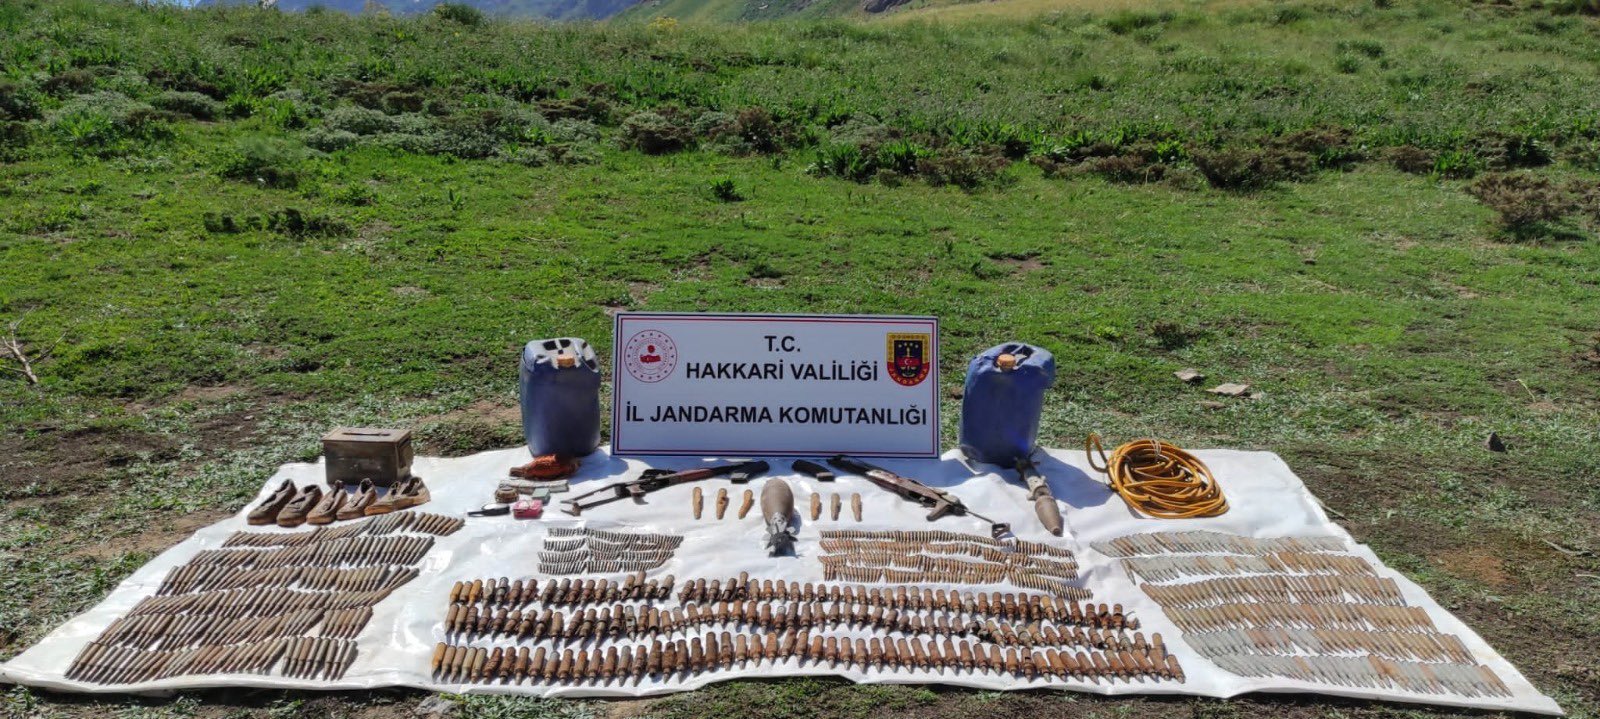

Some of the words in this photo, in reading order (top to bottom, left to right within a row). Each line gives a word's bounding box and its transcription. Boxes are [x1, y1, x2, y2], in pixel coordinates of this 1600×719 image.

[764, 335, 801, 352] T.C.
[686, 358, 784, 380] HAKKARİ
[790, 359, 878, 381] VALİLİĞİ
[626, 401, 645, 422] İL
[649, 405, 773, 424] JANDARMA
[779, 404, 927, 425] KOMUTANLIĞI
